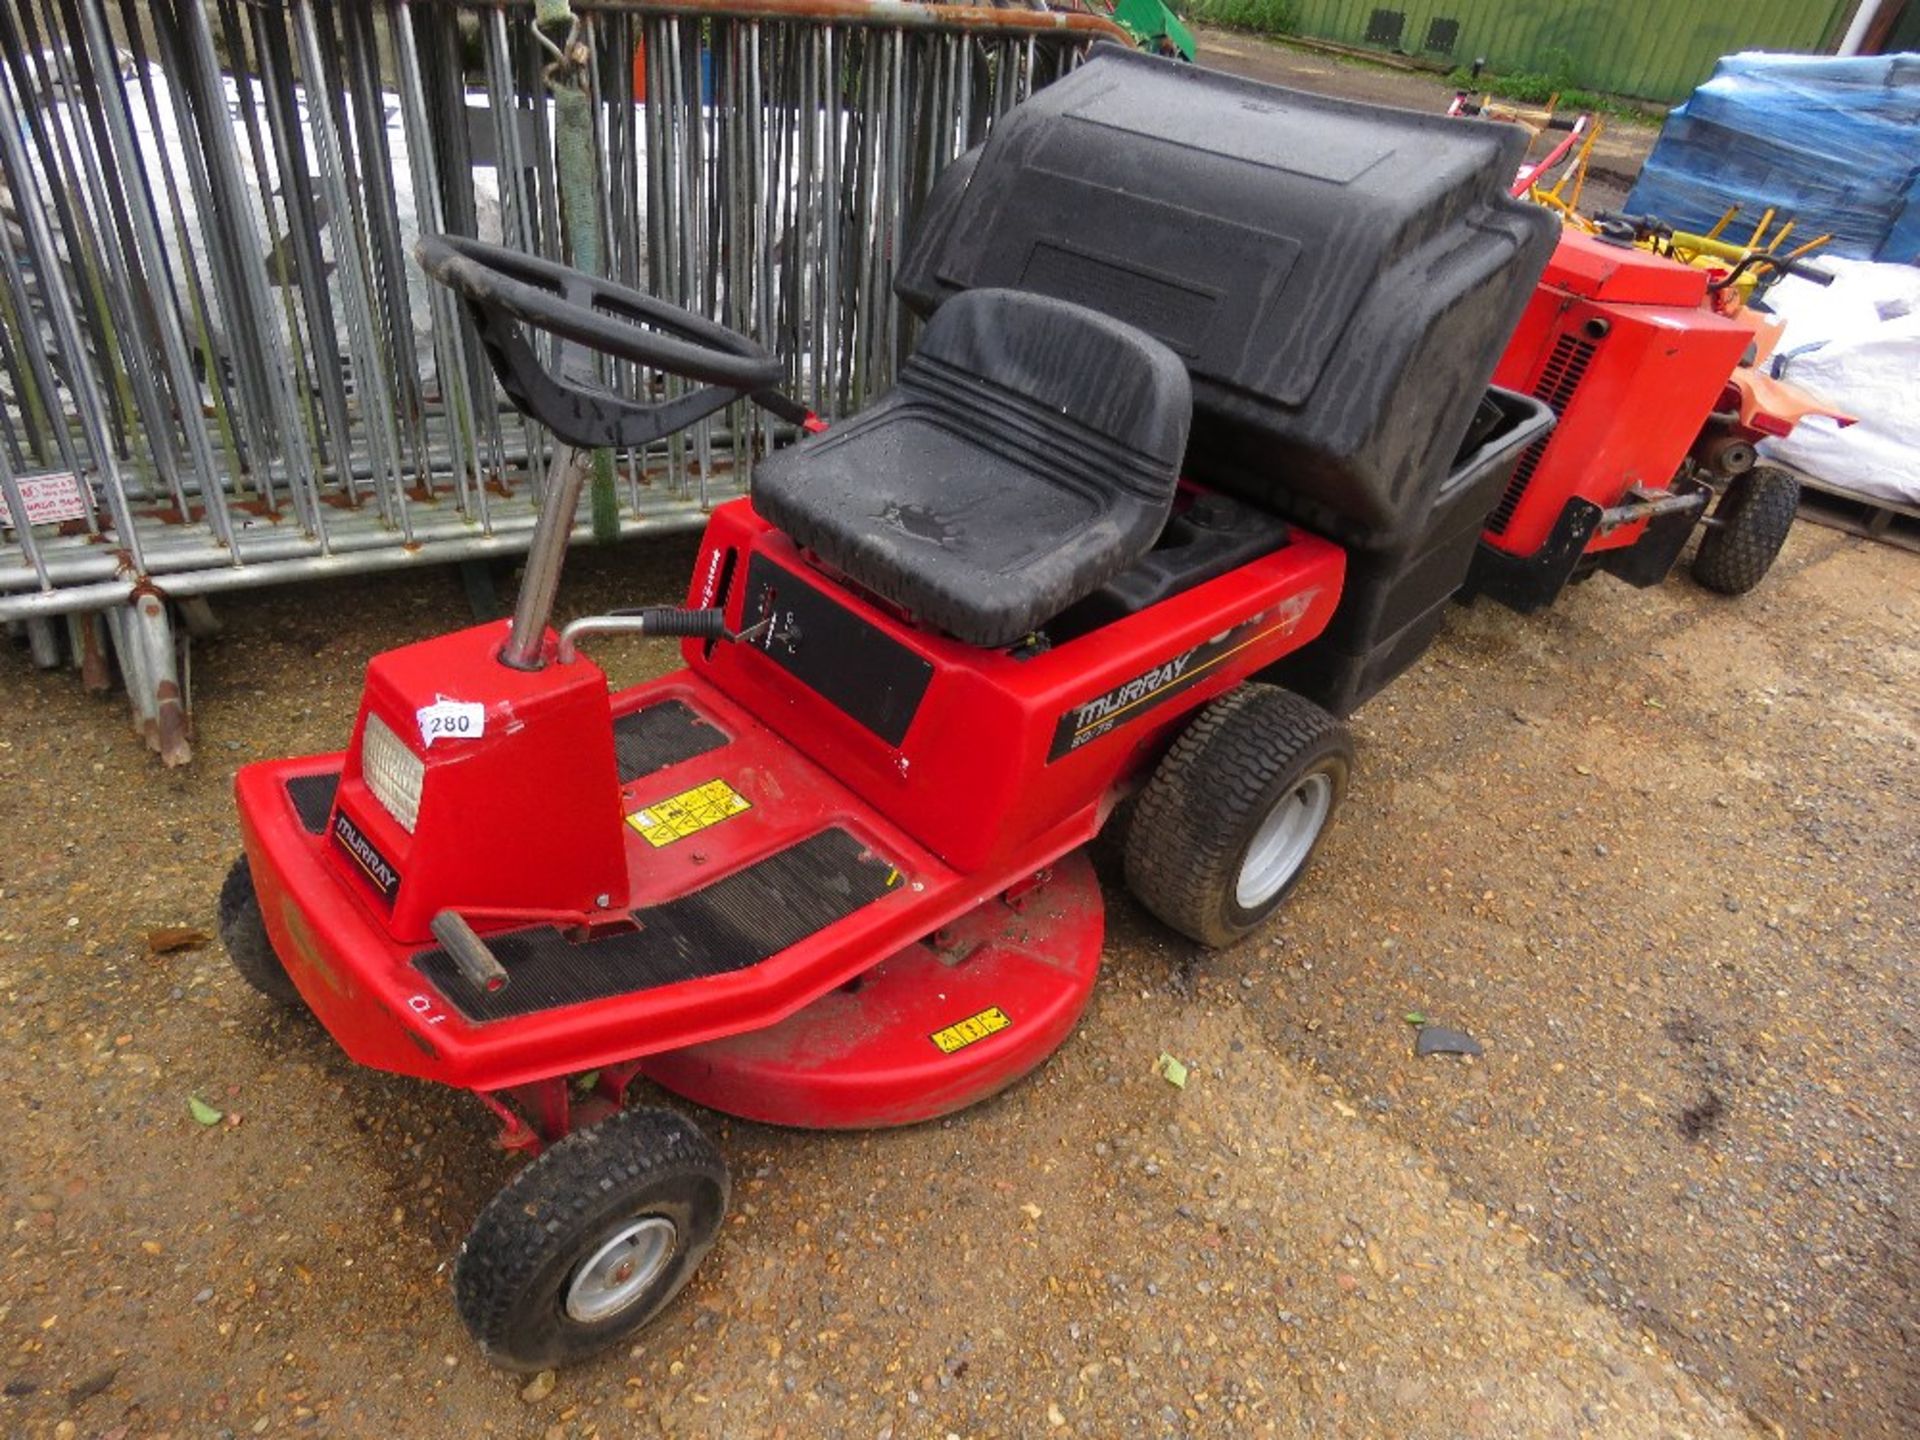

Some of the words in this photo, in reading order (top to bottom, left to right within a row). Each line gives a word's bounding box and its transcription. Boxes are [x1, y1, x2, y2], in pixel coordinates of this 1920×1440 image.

[430, 714, 470, 734] 280
[1077, 650, 1195, 729] MURRAY
[337, 817, 397, 887] MURRAY
